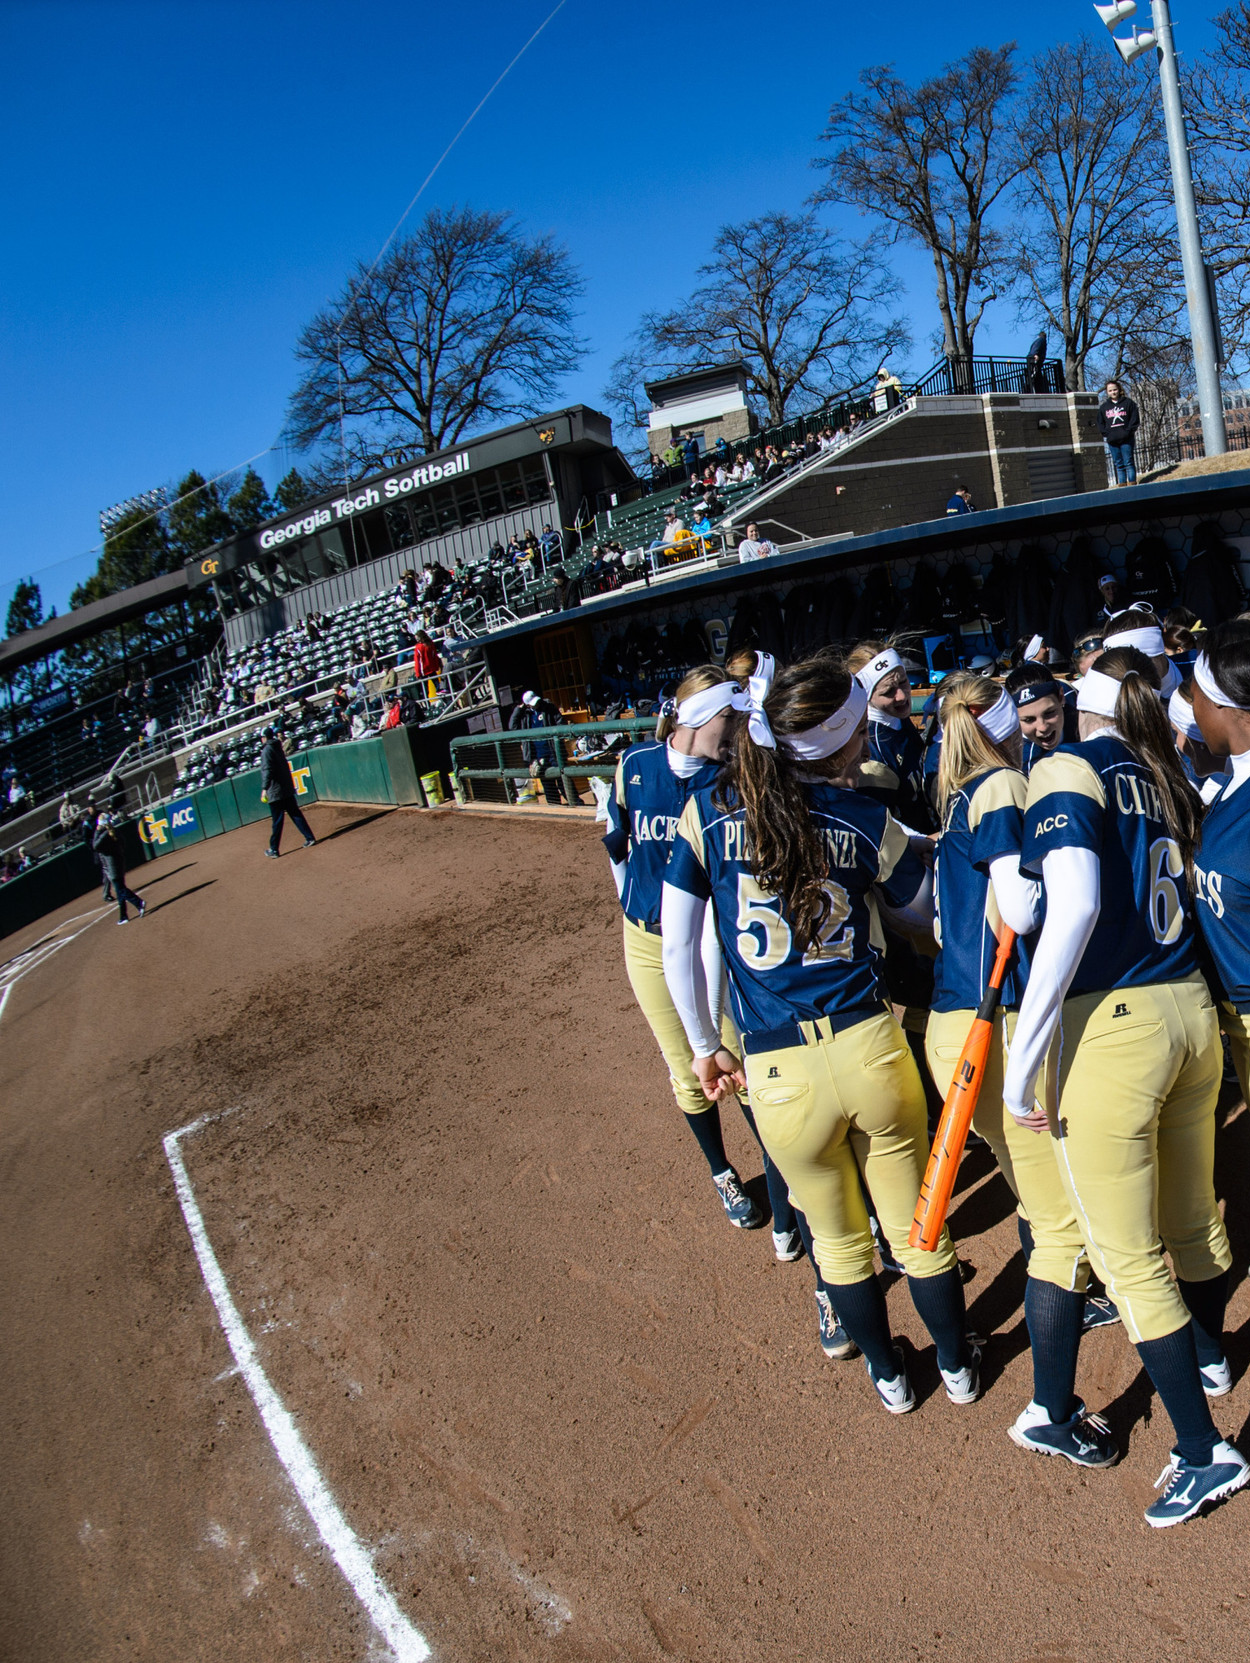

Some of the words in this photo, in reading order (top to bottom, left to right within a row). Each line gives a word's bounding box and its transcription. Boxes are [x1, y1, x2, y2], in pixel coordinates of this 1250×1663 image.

[260, 508, 331, 549] Georgia
[331, 487, 380, 519] Tech
[384, 452, 470, 498] Softball
[200, 558, 220, 575] GT
[138, 812, 168, 845] GT
[172, 806, 195, 829] ACC
[1034, 813, 1069, 839] ACC
[1148, 836, 1184, 945] 6
[736, 872, 855, 971] 52
